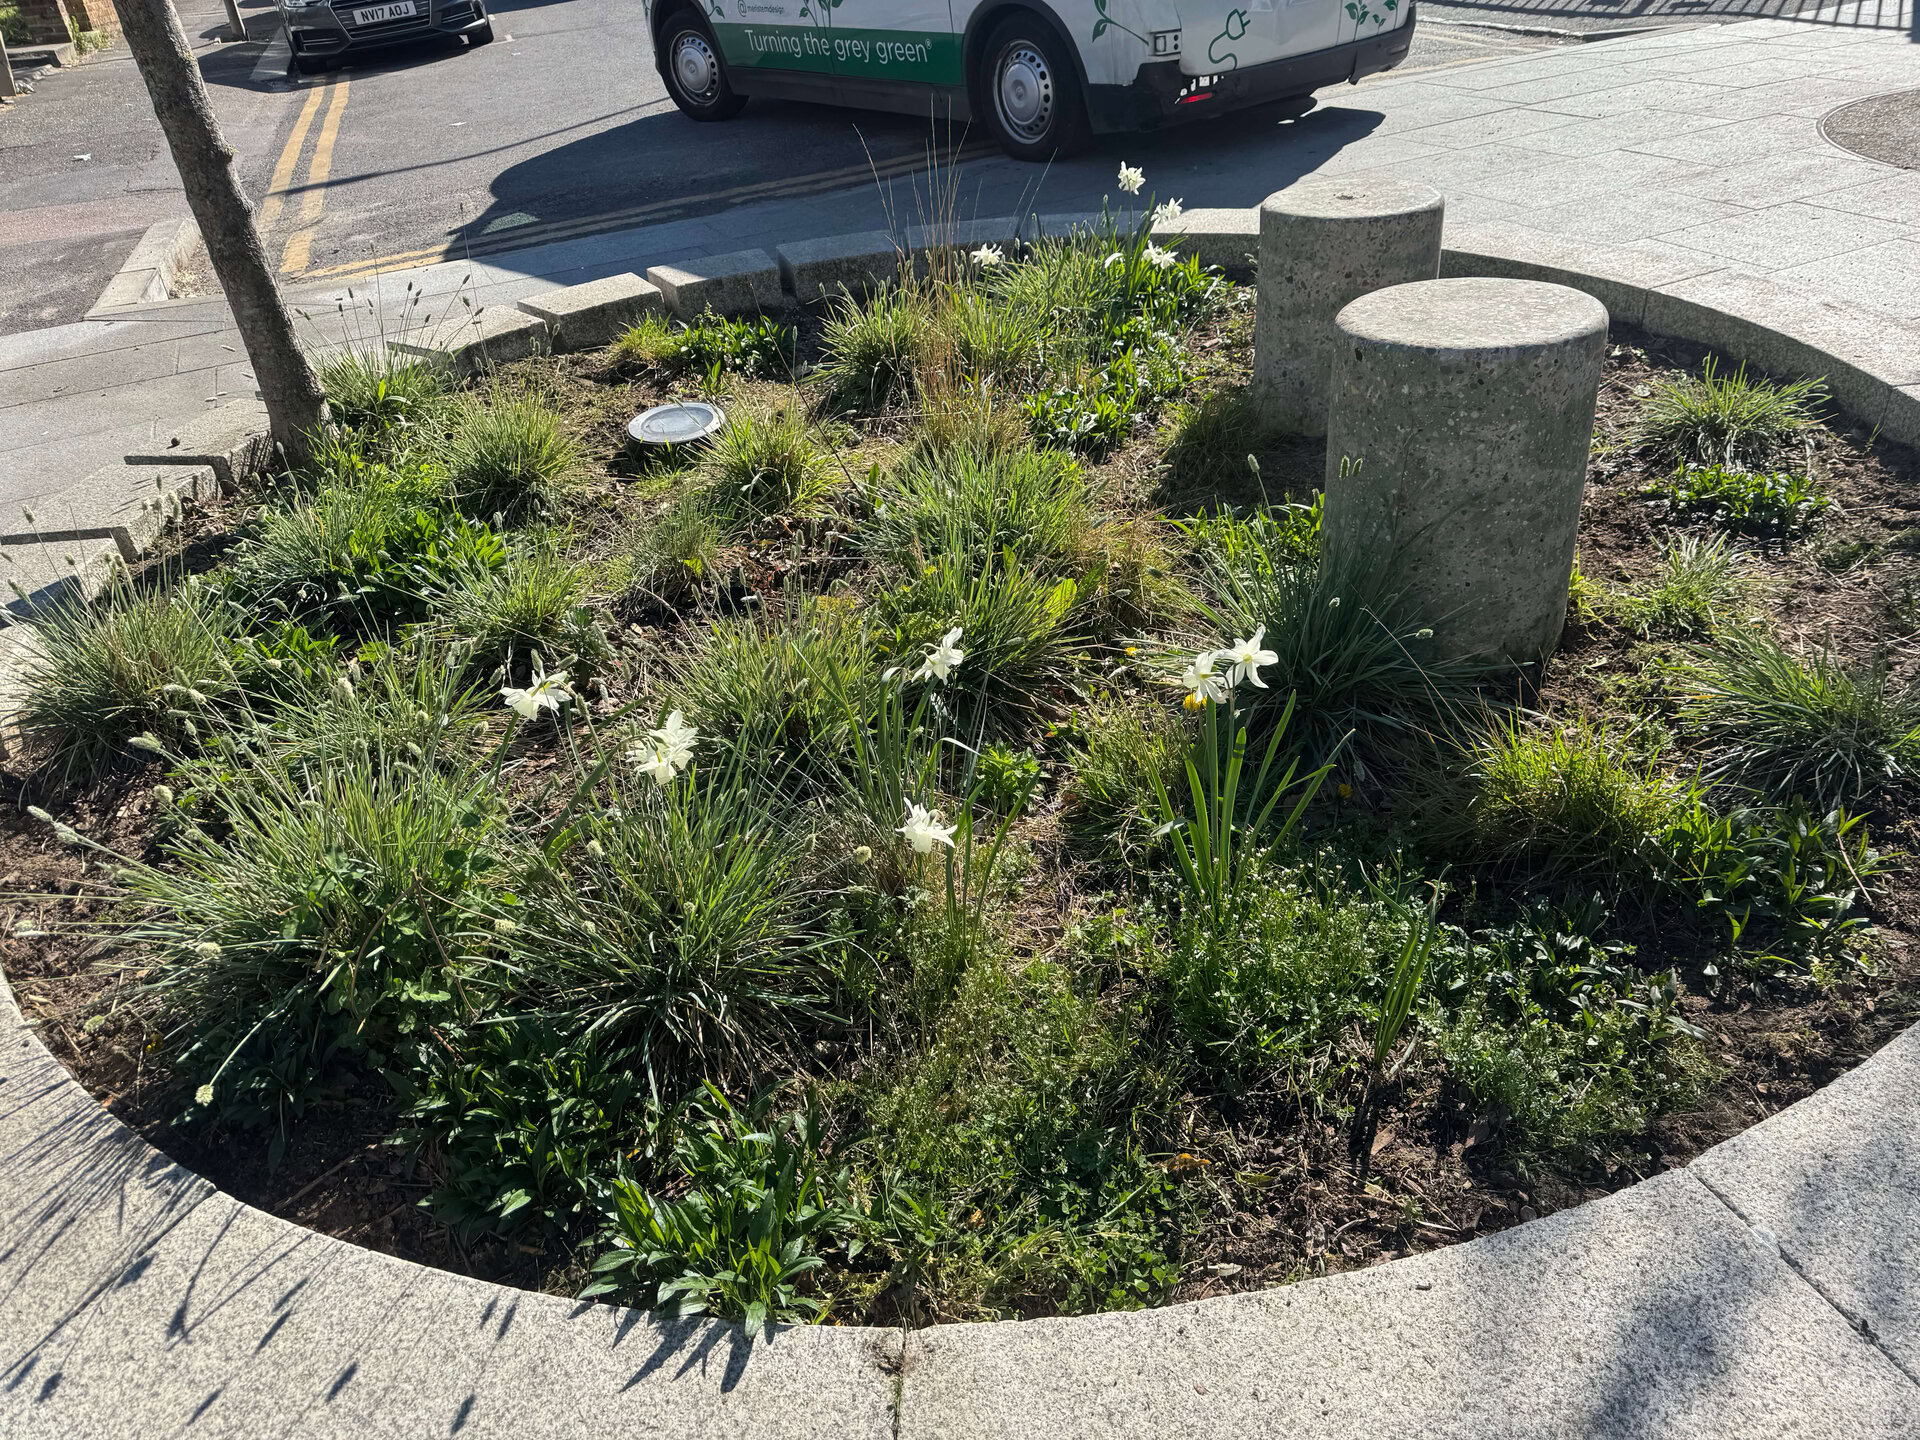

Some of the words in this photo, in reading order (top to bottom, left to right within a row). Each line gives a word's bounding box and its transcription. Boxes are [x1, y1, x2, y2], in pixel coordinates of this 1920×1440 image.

[360, 9, 385, 22] NV17
[388, 3, 410, 18] AOJ
[744, 29, 801, 58] Turning
[803, 32, 830, 56] the
[834, 39, 870, 63] grey
